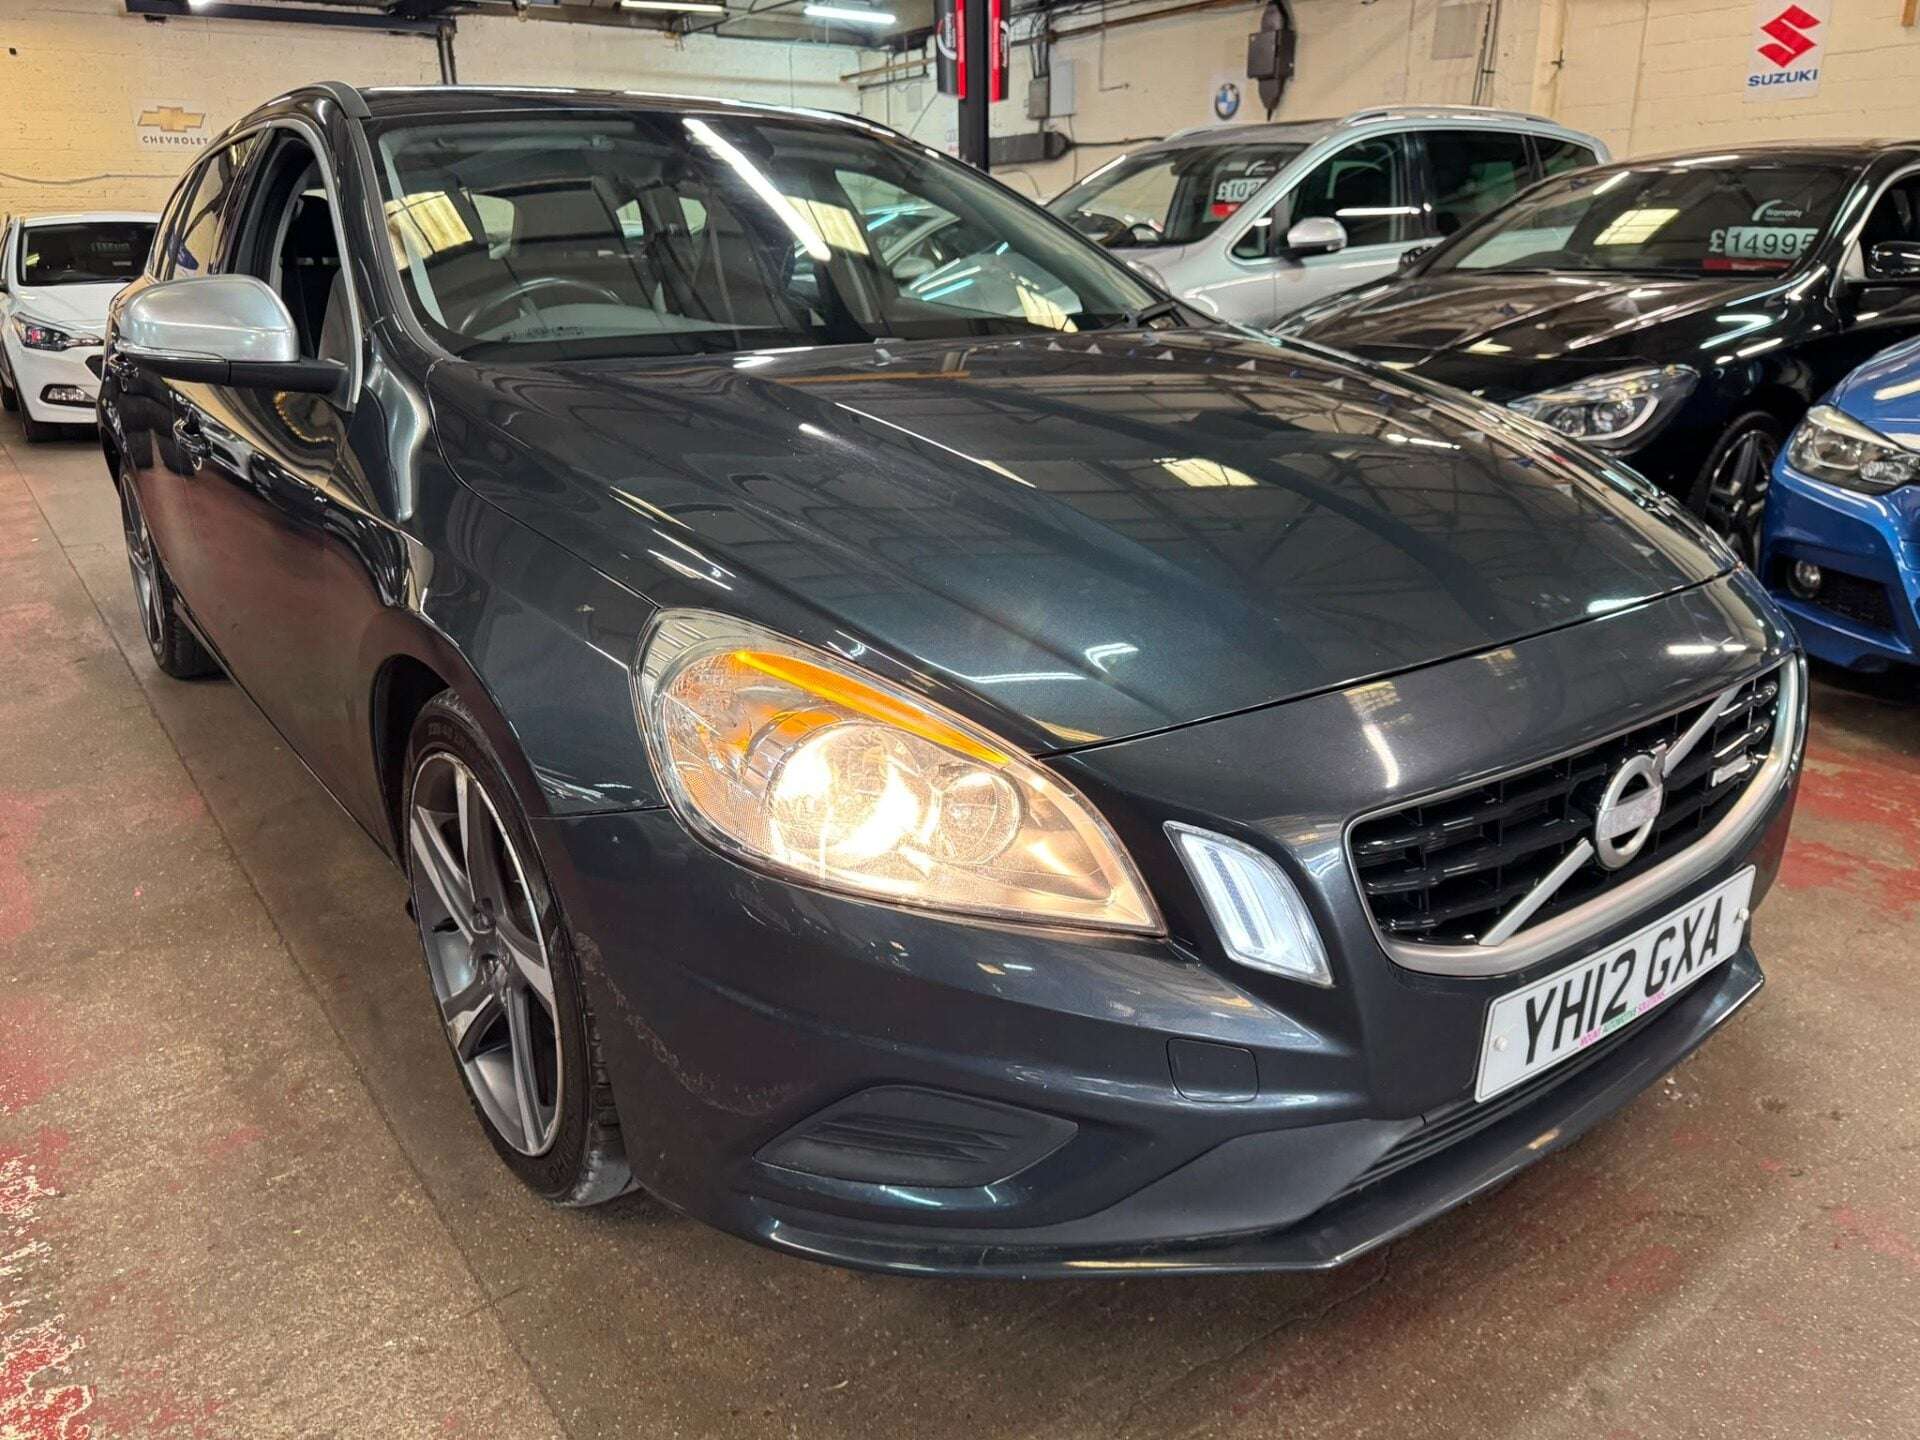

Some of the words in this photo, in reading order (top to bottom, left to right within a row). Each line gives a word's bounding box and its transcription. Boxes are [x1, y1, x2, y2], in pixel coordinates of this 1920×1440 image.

[1747, 69, 1819, 87] SUZUKI
[142, 135, 208, 145] CHEVROLET
[1524, 948, 1637, 1066] YH12
[1644, 896, 1723, 998] GXA
